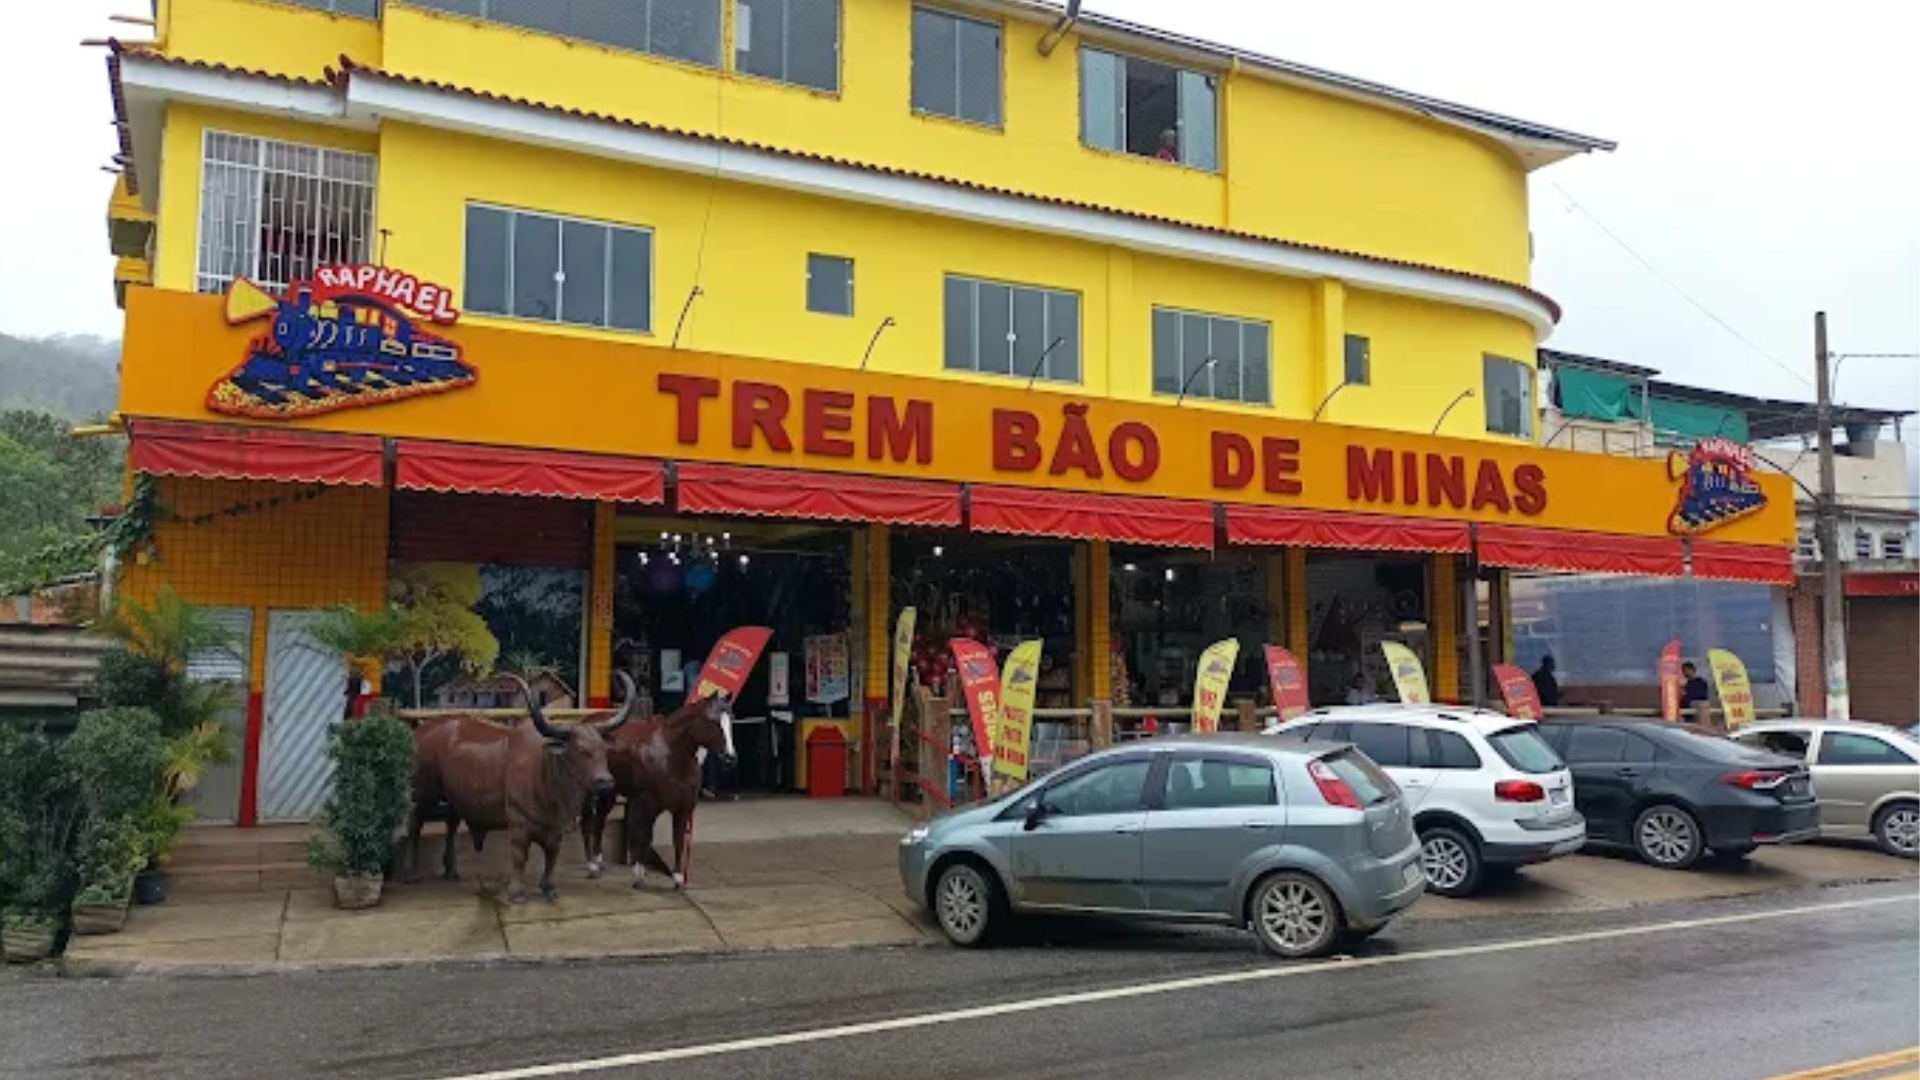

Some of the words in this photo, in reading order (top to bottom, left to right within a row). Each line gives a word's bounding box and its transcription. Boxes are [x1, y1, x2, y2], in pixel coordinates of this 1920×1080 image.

[318, 266, 456, 319] RAPHAEL
[657, 373, 933, 465] TREM
[992, 402, 1161, 483] BÃO
[1210, 430, 1303, 496] DE
[1345, 444, 1548, 517] MINAS
